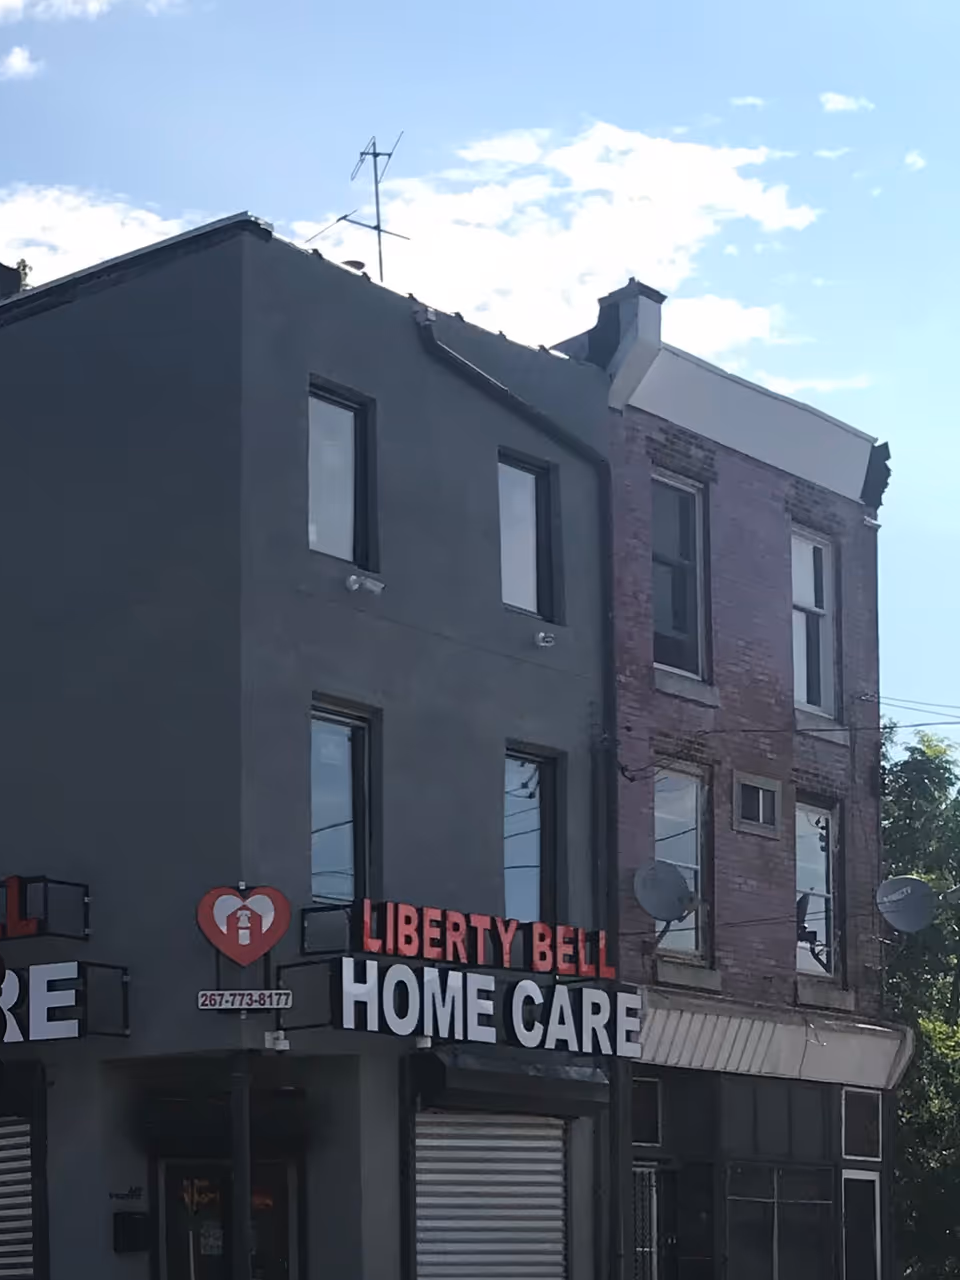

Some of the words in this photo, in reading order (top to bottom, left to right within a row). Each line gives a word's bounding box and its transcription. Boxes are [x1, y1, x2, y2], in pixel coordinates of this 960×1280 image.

[362, 898, 518, 968] LIBERTY
[531, 922, 616, 979] BELL
[200, 992, 291, 1007] 267-773-8177
[341, 957, 497, 1043] HOME
[512, 979, 642, 1058] CARE
